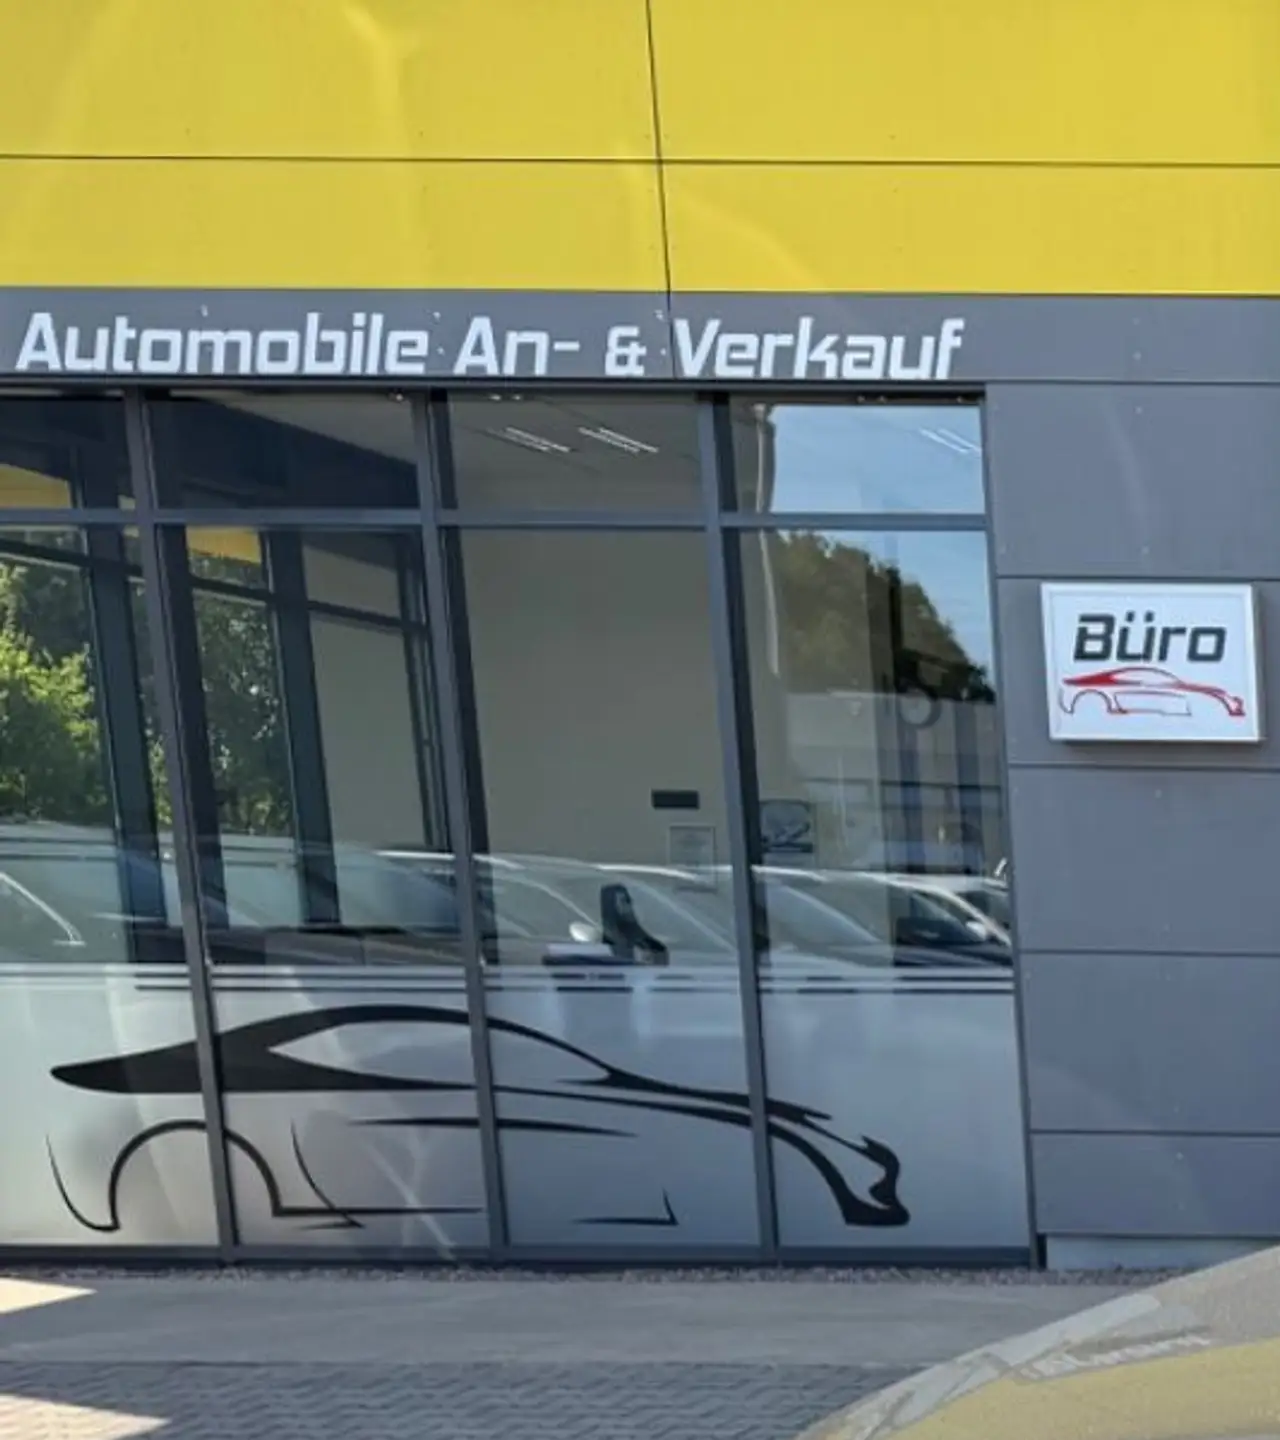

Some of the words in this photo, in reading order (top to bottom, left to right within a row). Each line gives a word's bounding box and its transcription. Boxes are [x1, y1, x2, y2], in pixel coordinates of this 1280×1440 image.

[15, 312, 428, 374] Automobile
[452, 316, 580, 375] An-
[604, 325, 647, 376] &
[674, 317, 964, 380] Verkauf
[1073, 610, 1227, 662] Büro
